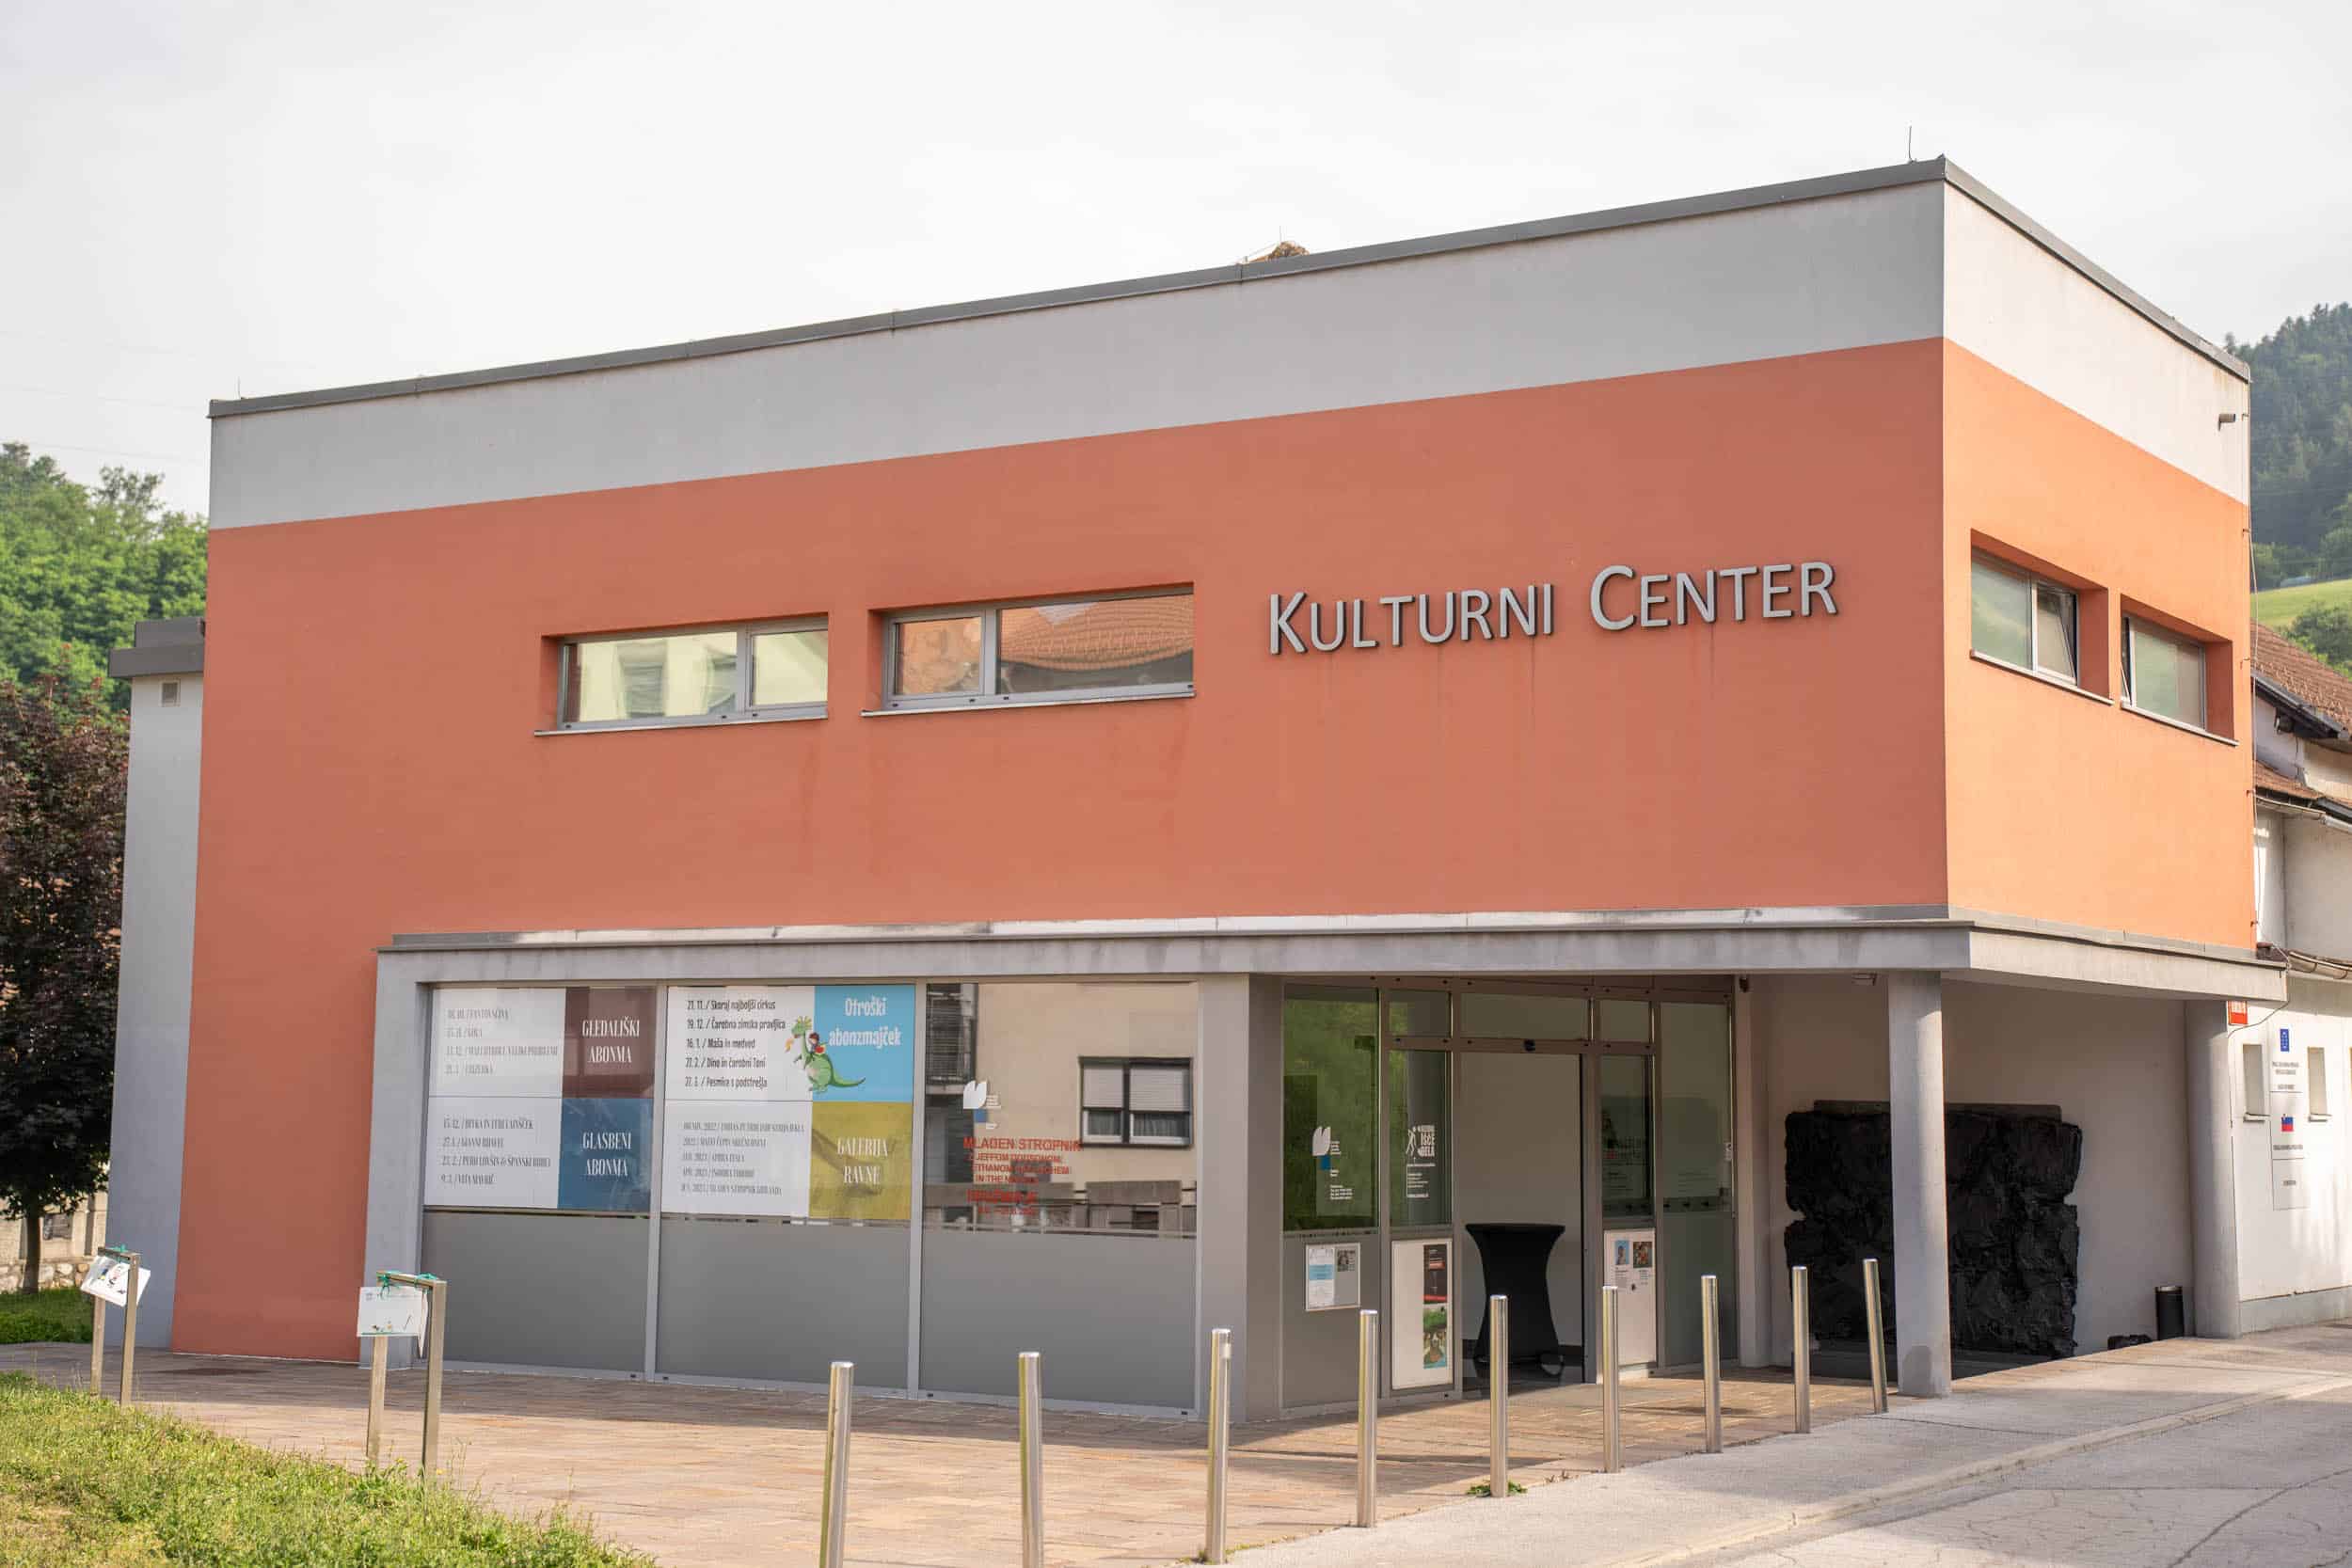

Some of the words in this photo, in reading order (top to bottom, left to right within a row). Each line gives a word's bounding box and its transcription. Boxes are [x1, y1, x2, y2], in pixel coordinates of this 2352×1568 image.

[1269, 583, 1554, 656] KULTURNI
[1590, 562, 1838, 632] CENTER
[711, 1000, 730, 1011] Skoraj
[731, 1000, 755, 1011] najboljši
[757, 1000, 775, 1009] cirkus
[845, 996, 887, 1017] Otroški
[581, 1016, 640, 1037] GLEDALIŠKI
[711, 1017, 736, 1029] Čarobna
[759, 1019, 786, 1031] pravljica
[707, 1038, 723, 1048] Maša
[724, 1038, 730, 1047] in
[732, 1038, 755, 1049] medved
[829, 1026, 901, 1049] abonzmajček
[587, 1046, 632, 1064] ABONMA
[707, 1057, 720, 1068] Dino
[581, 1132, 632, 1150] GLASBENI
[837, 1137, 888, 1158] GALERIJA
[962, 1136, 1015, 1149] MLADEN
[585, 1159, 628, 1177] ABONMA
[843, 1165, 881, 1185] RAVNE
